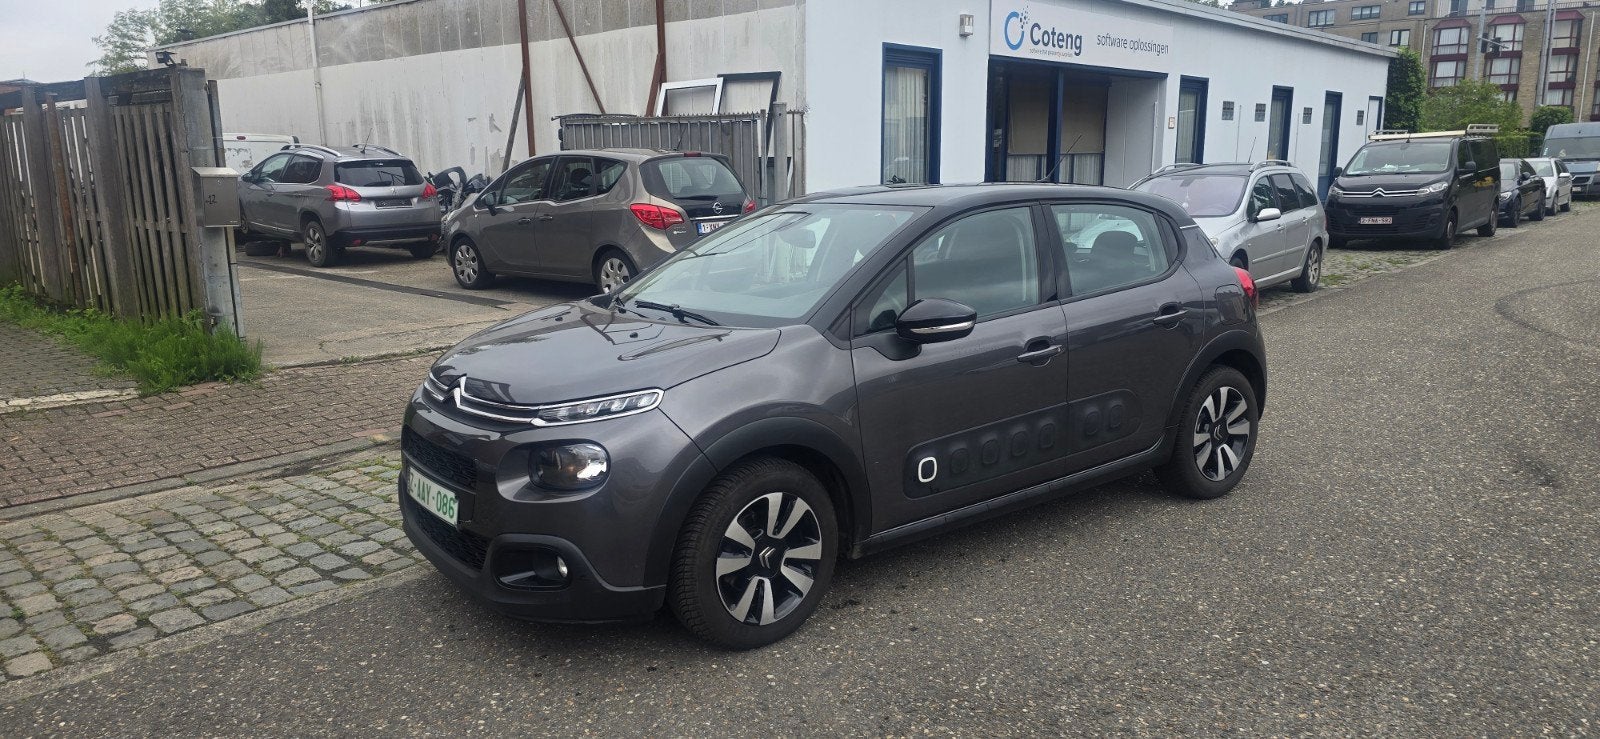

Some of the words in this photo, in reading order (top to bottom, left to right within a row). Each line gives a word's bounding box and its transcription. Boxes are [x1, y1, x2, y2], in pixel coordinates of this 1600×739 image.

[1030, 22, 1083, 57] Coteng
[1096, 32, 1128, 49] software
[1129, 38, 1169, 57] oplossingen
[408, 471, 455, 519] Z-AAY-086
